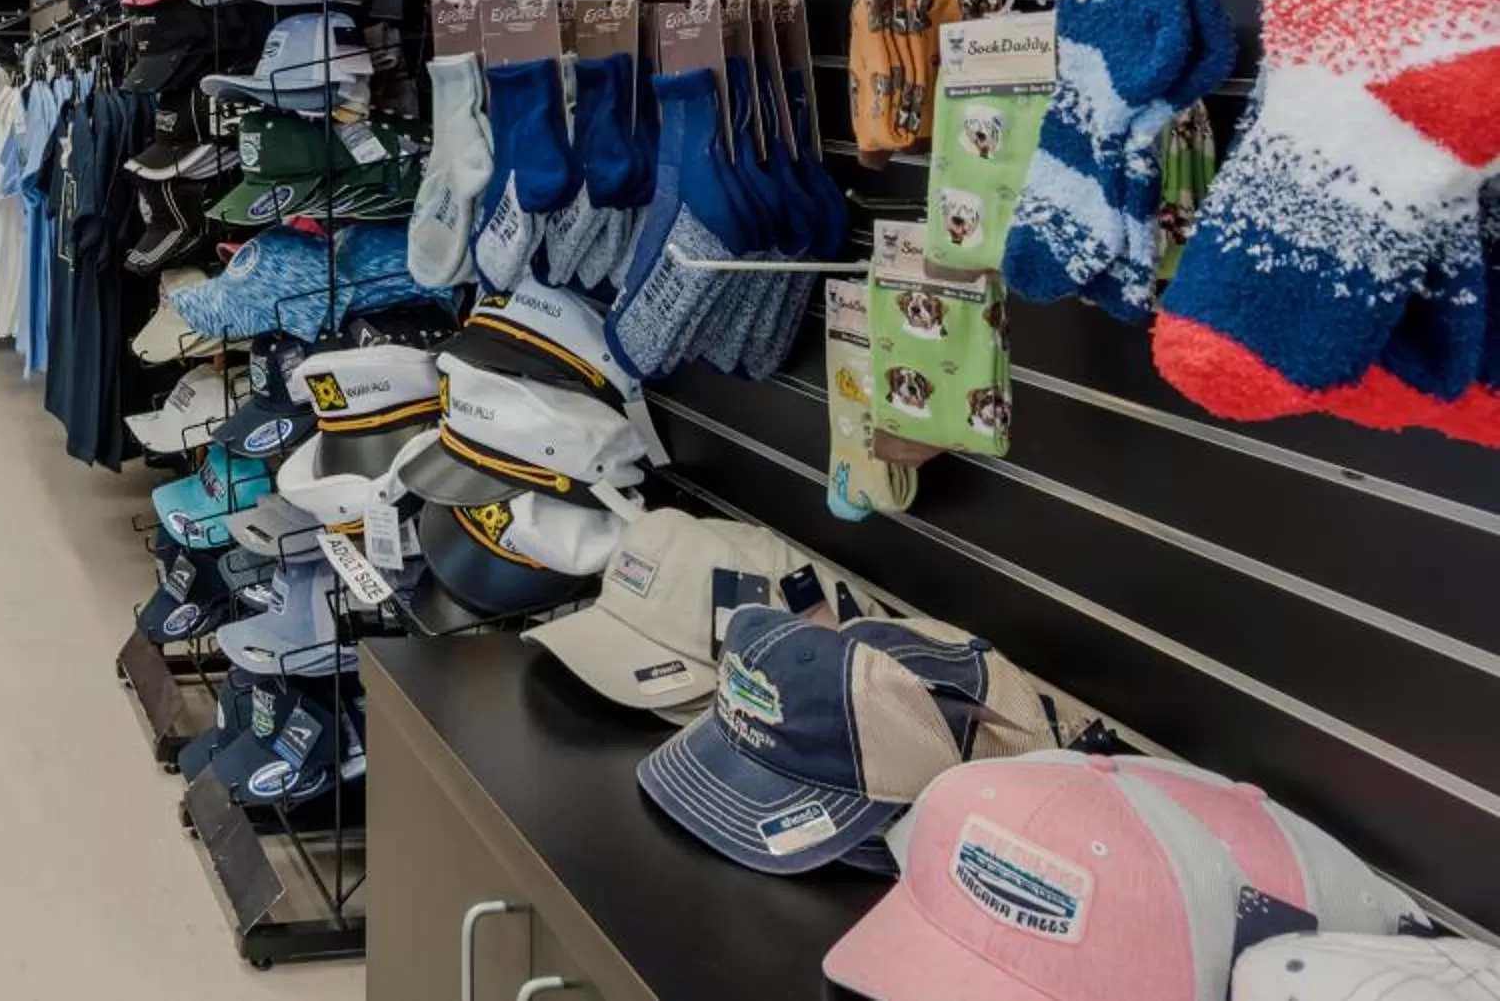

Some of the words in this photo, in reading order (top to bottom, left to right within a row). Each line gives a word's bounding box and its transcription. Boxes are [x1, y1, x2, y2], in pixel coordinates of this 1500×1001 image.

[329, 540, 365, 573] ADULT
[354, 571, 385, 600] SIZE
[955, 863, 1012, 919] NIAGARA
[1015, 910, 1072, 935] FALLS
